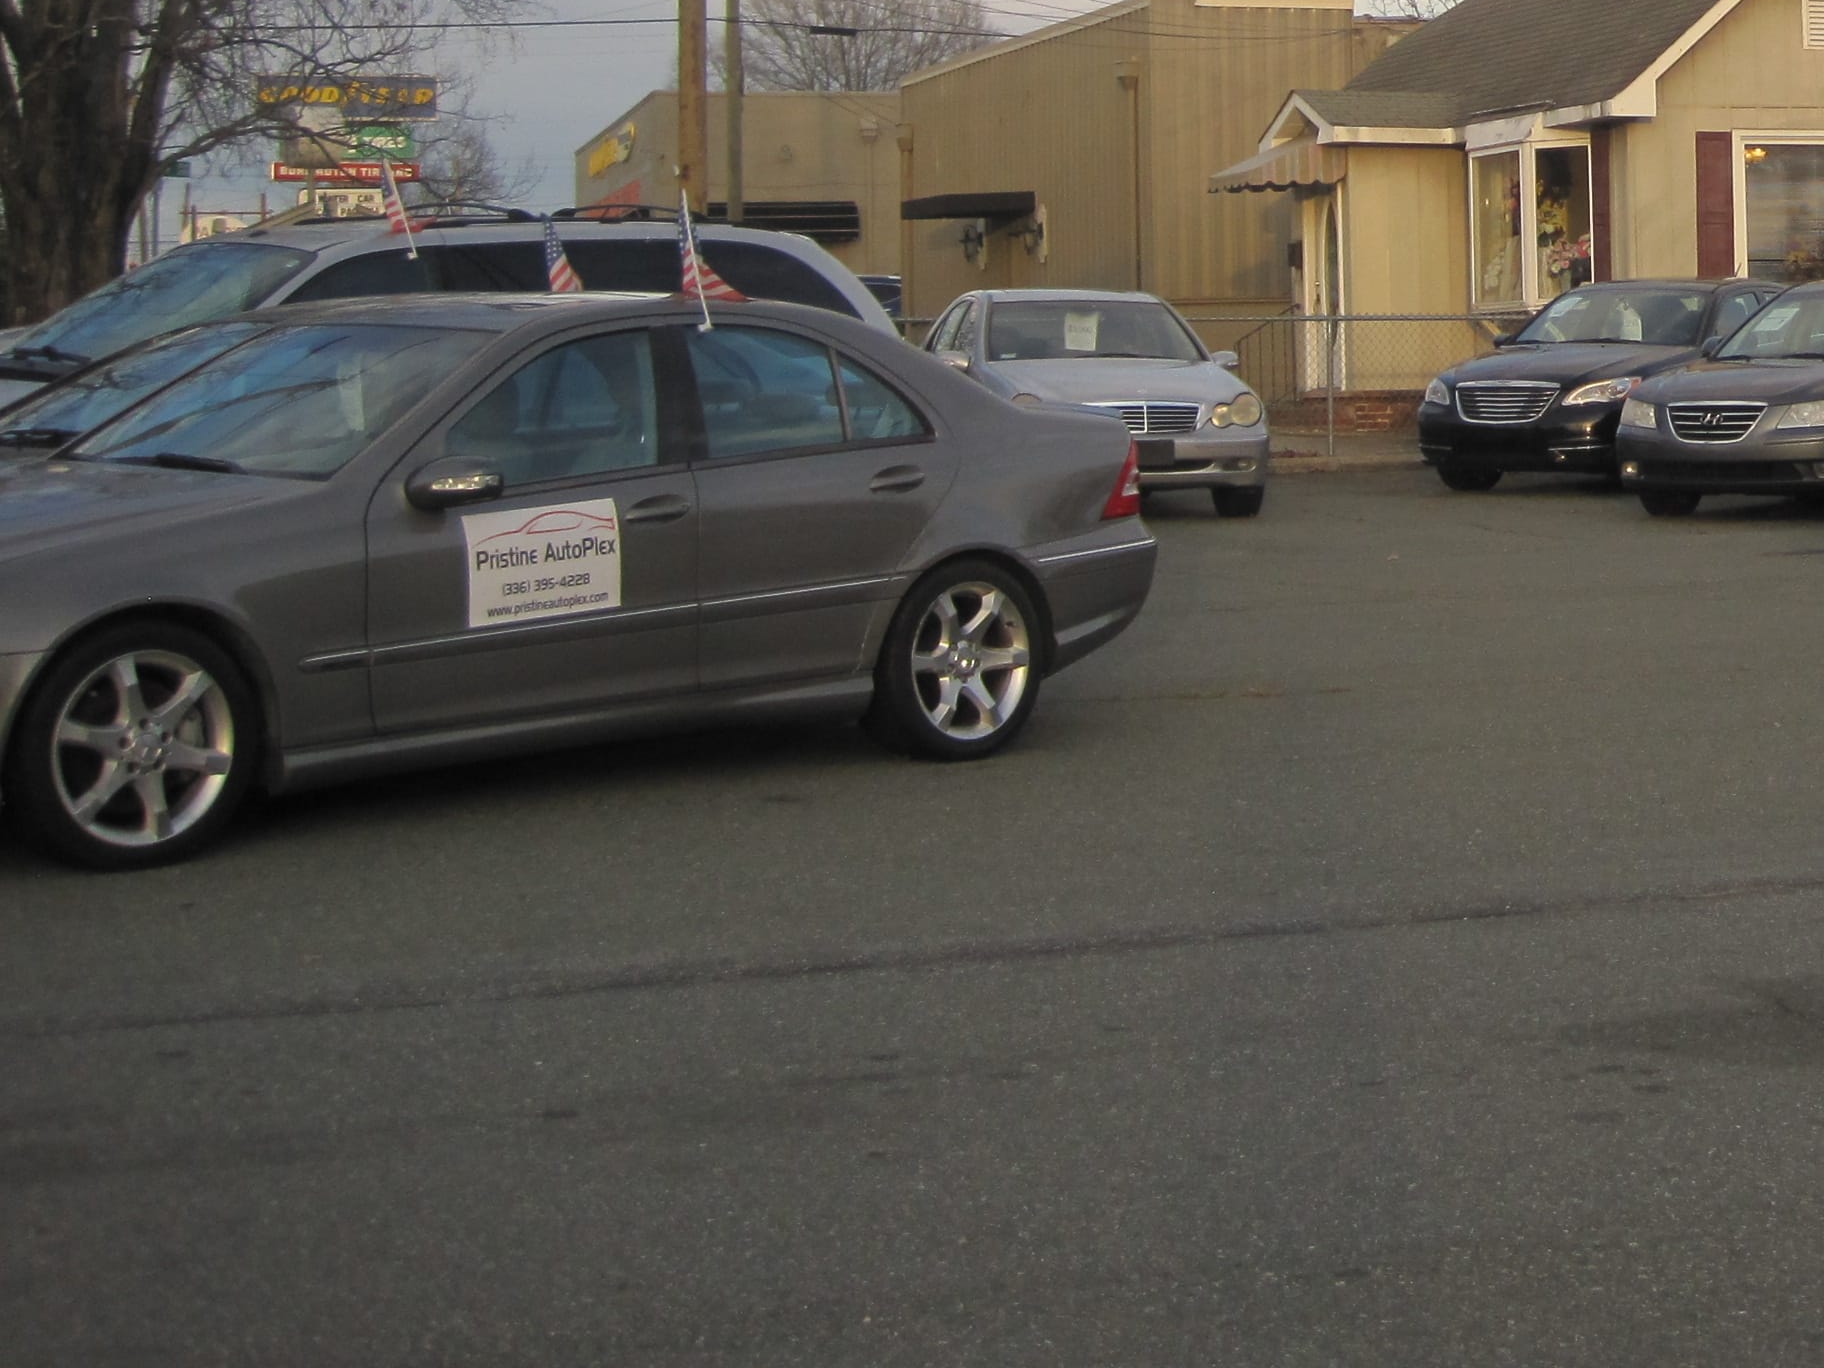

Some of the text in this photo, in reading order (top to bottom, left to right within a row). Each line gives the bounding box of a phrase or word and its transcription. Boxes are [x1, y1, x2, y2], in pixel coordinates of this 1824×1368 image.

[476, 537, 616, 571] Pristine AutoPlex
[502, 573, 591, 596] (336) 395-4228
[487, 592, 609, 617] www.pristineautoplex.com
